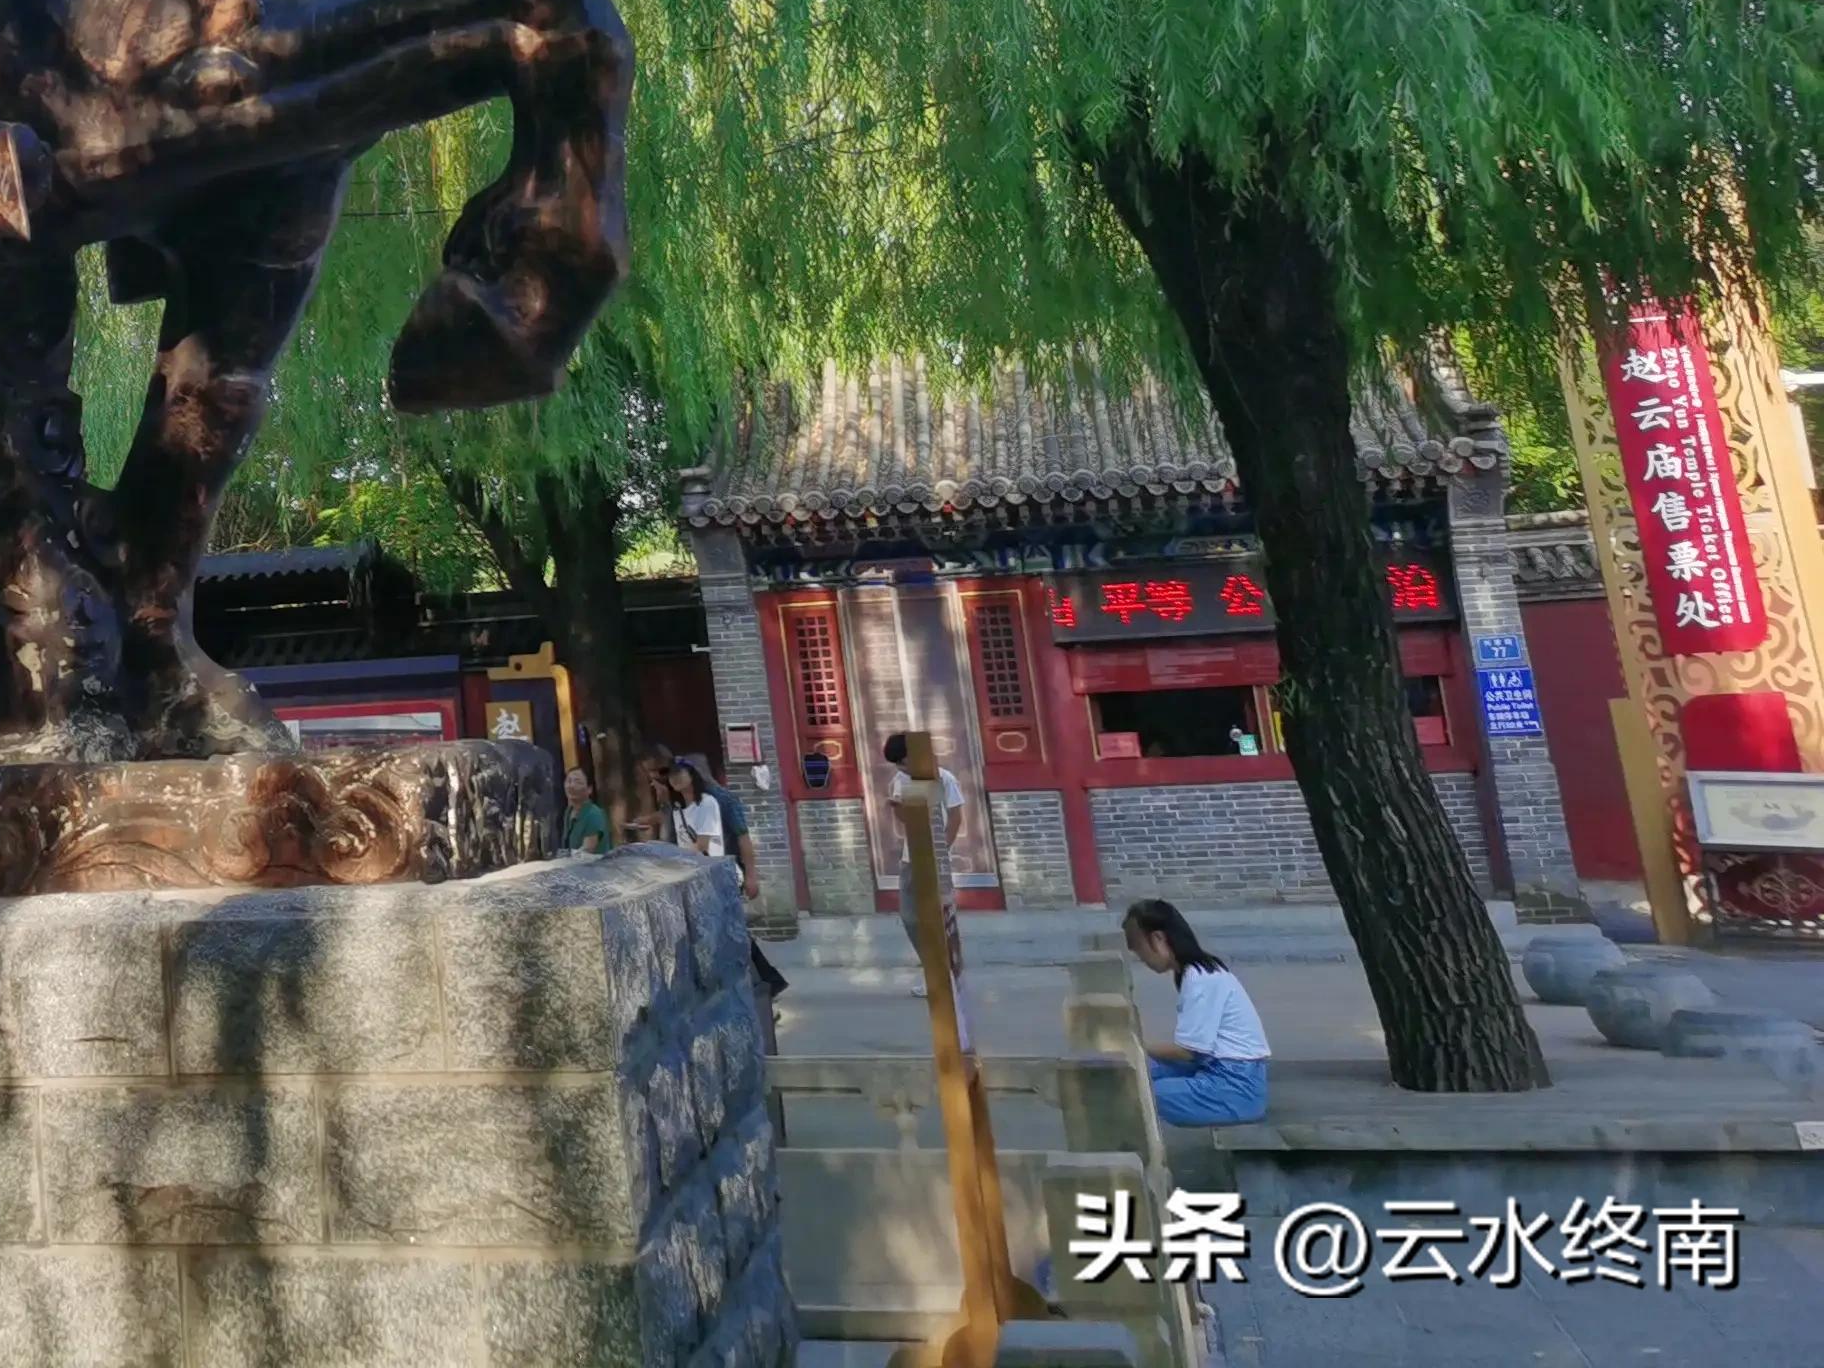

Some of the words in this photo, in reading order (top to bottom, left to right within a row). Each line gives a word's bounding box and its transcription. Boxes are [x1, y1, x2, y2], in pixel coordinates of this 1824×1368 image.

[1661, 347, 1681, 389] Zhao
[1671, 394, 1690, 429] Yun
[1620, 348, 1722, 628] 赵云庙售票处
[1680, 435, 1707, 499] Temple
[1696, 504, 1722, 562] Ticket
[1100, 578, 1193, 625] 平等
[1710, 567, 1735, 624] Office
